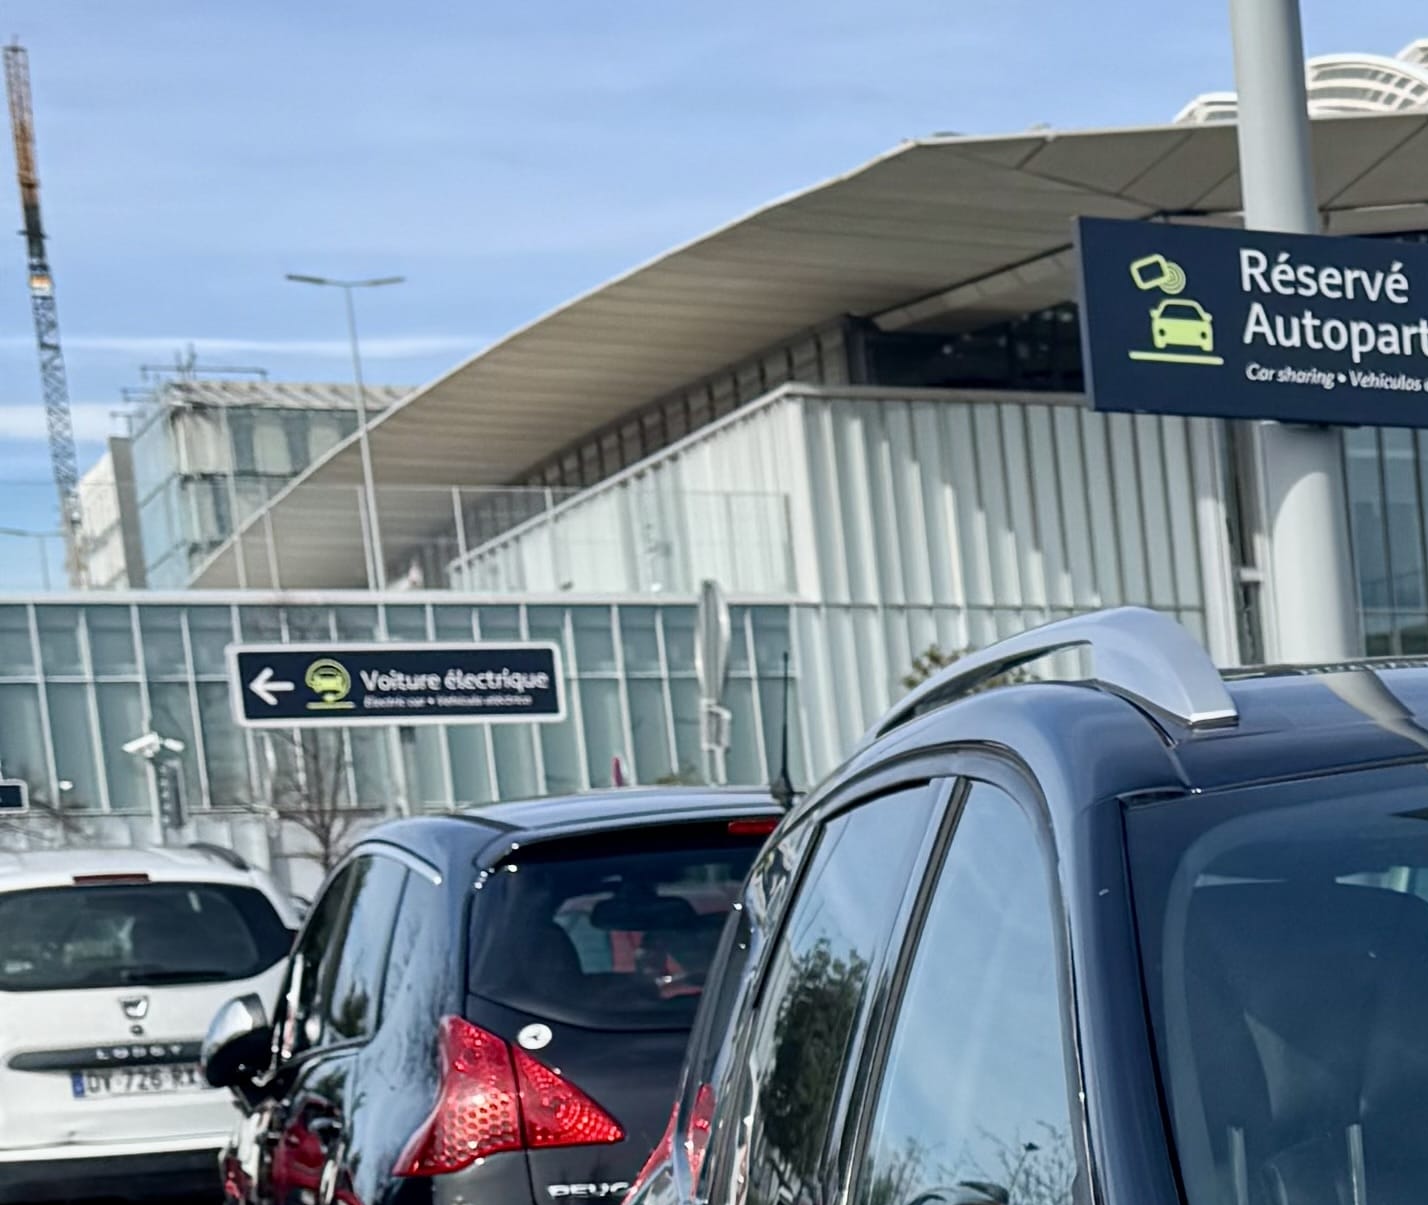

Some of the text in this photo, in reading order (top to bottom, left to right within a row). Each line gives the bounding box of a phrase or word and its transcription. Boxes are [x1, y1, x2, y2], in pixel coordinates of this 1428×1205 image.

[1239, 248, 1409, 304] Réservé
[1246, 363, 1274, 381] Car
[1276, 366, 1336, 390] sharing
[360, 667, 550, 693] Voiture électrique
